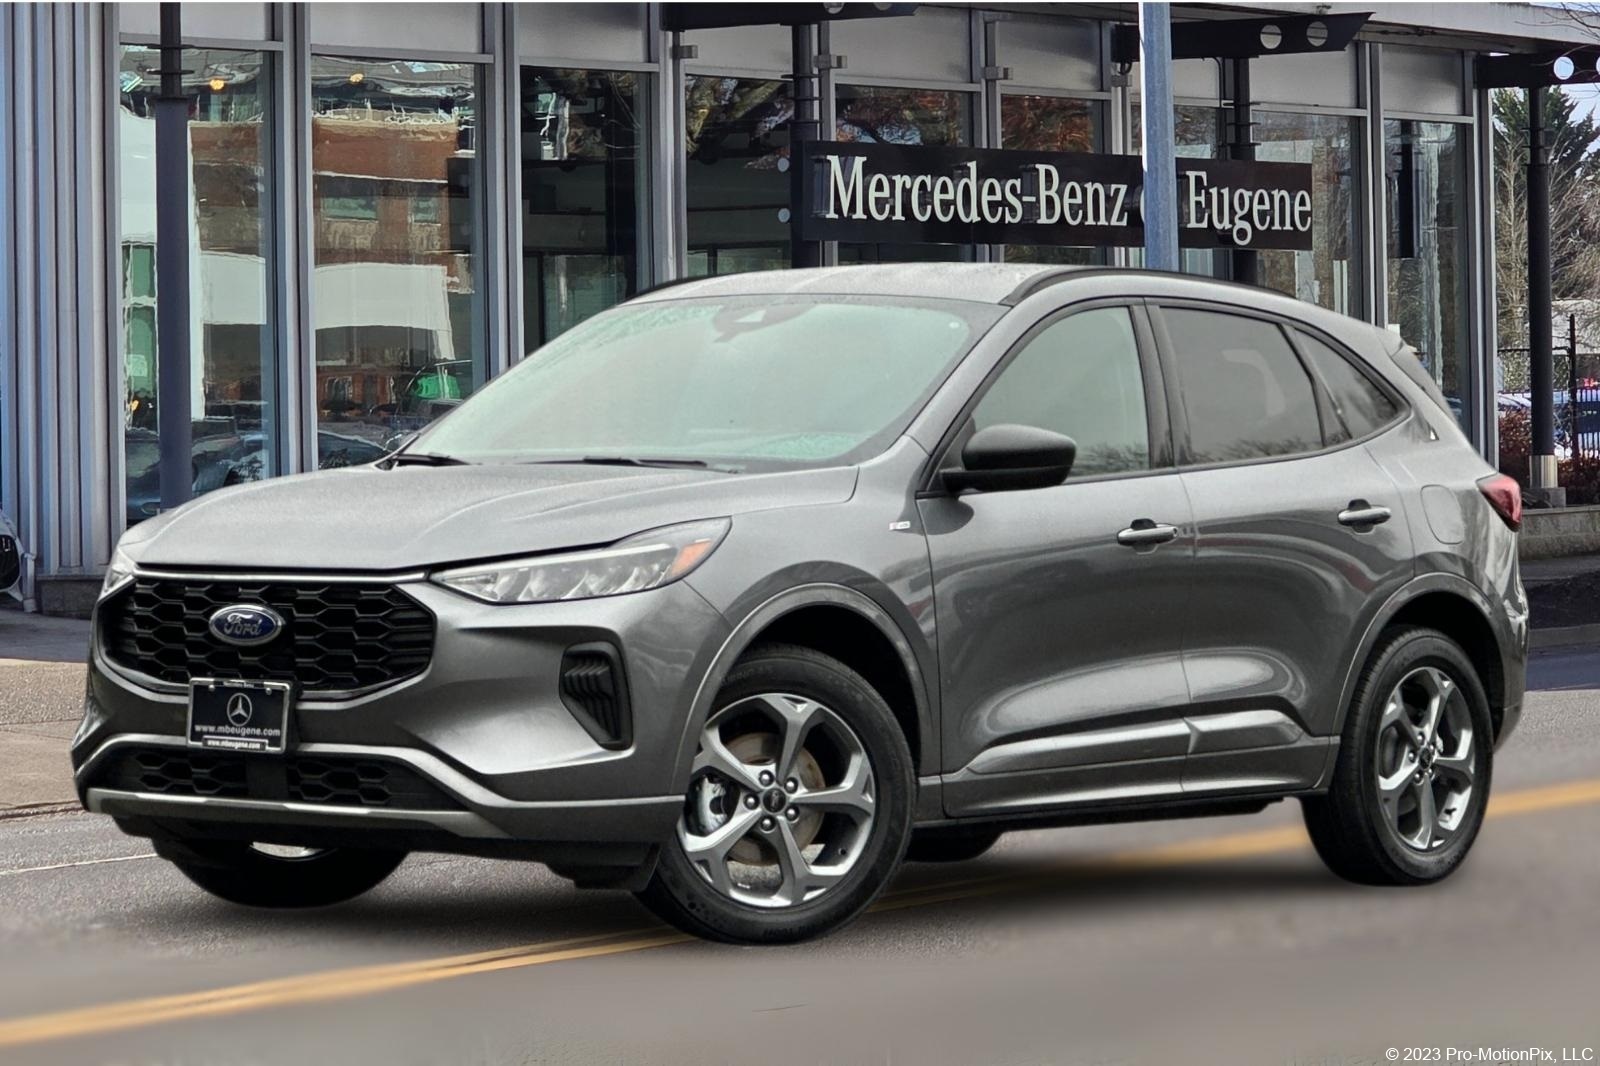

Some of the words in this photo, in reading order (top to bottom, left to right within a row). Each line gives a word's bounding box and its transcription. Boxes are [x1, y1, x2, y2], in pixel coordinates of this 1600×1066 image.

[826, 154, 1129, 227] Mercedes-Benz
[1185, 170, 1312, 246] Eugene
[223, 612, 263, 636] Ford
[194, 724, 281, 737] www.mbeugene.com
